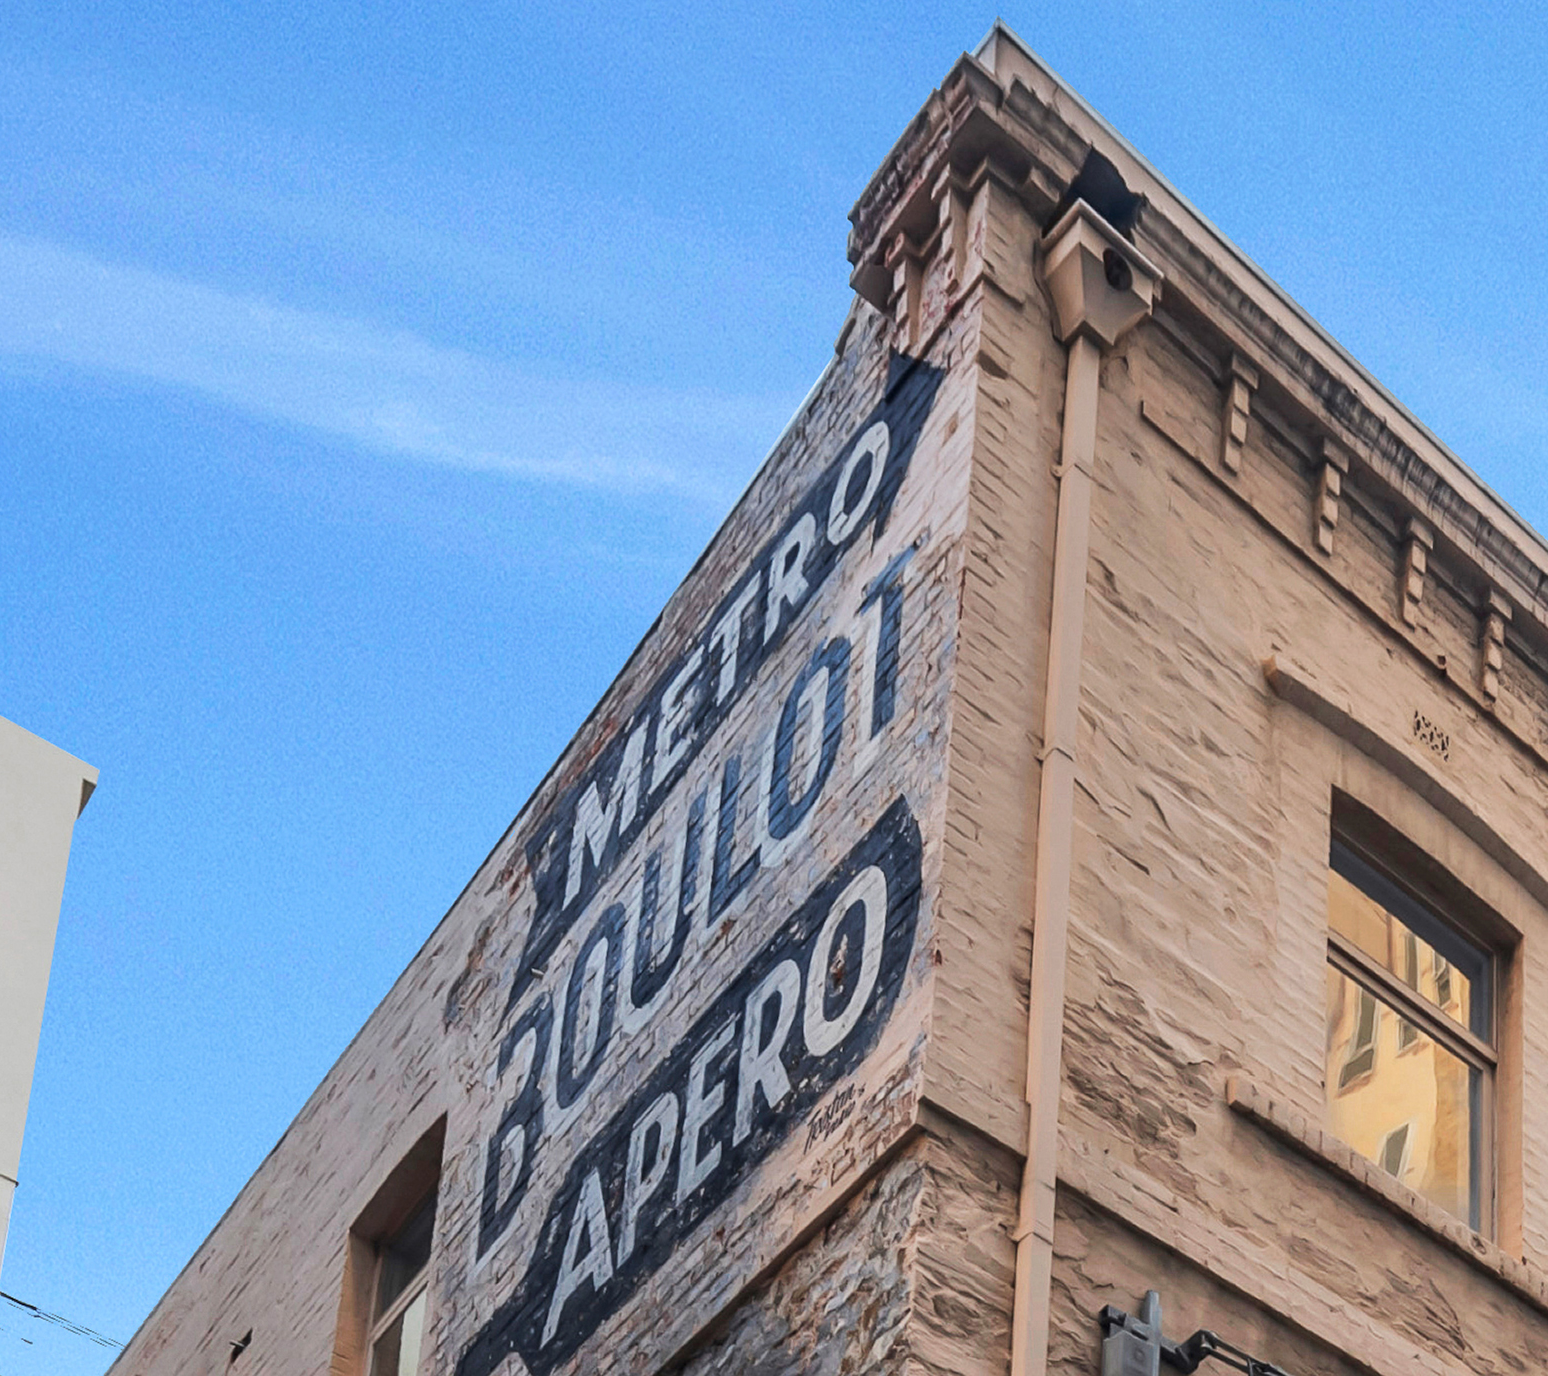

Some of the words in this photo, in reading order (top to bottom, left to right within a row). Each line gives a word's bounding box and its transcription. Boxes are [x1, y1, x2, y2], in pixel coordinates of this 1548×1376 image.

[562, 420, 891, 912] METRO
[470, 540, 922, 1285] BOULOT
[539, 864, 888, 1350] APERO
